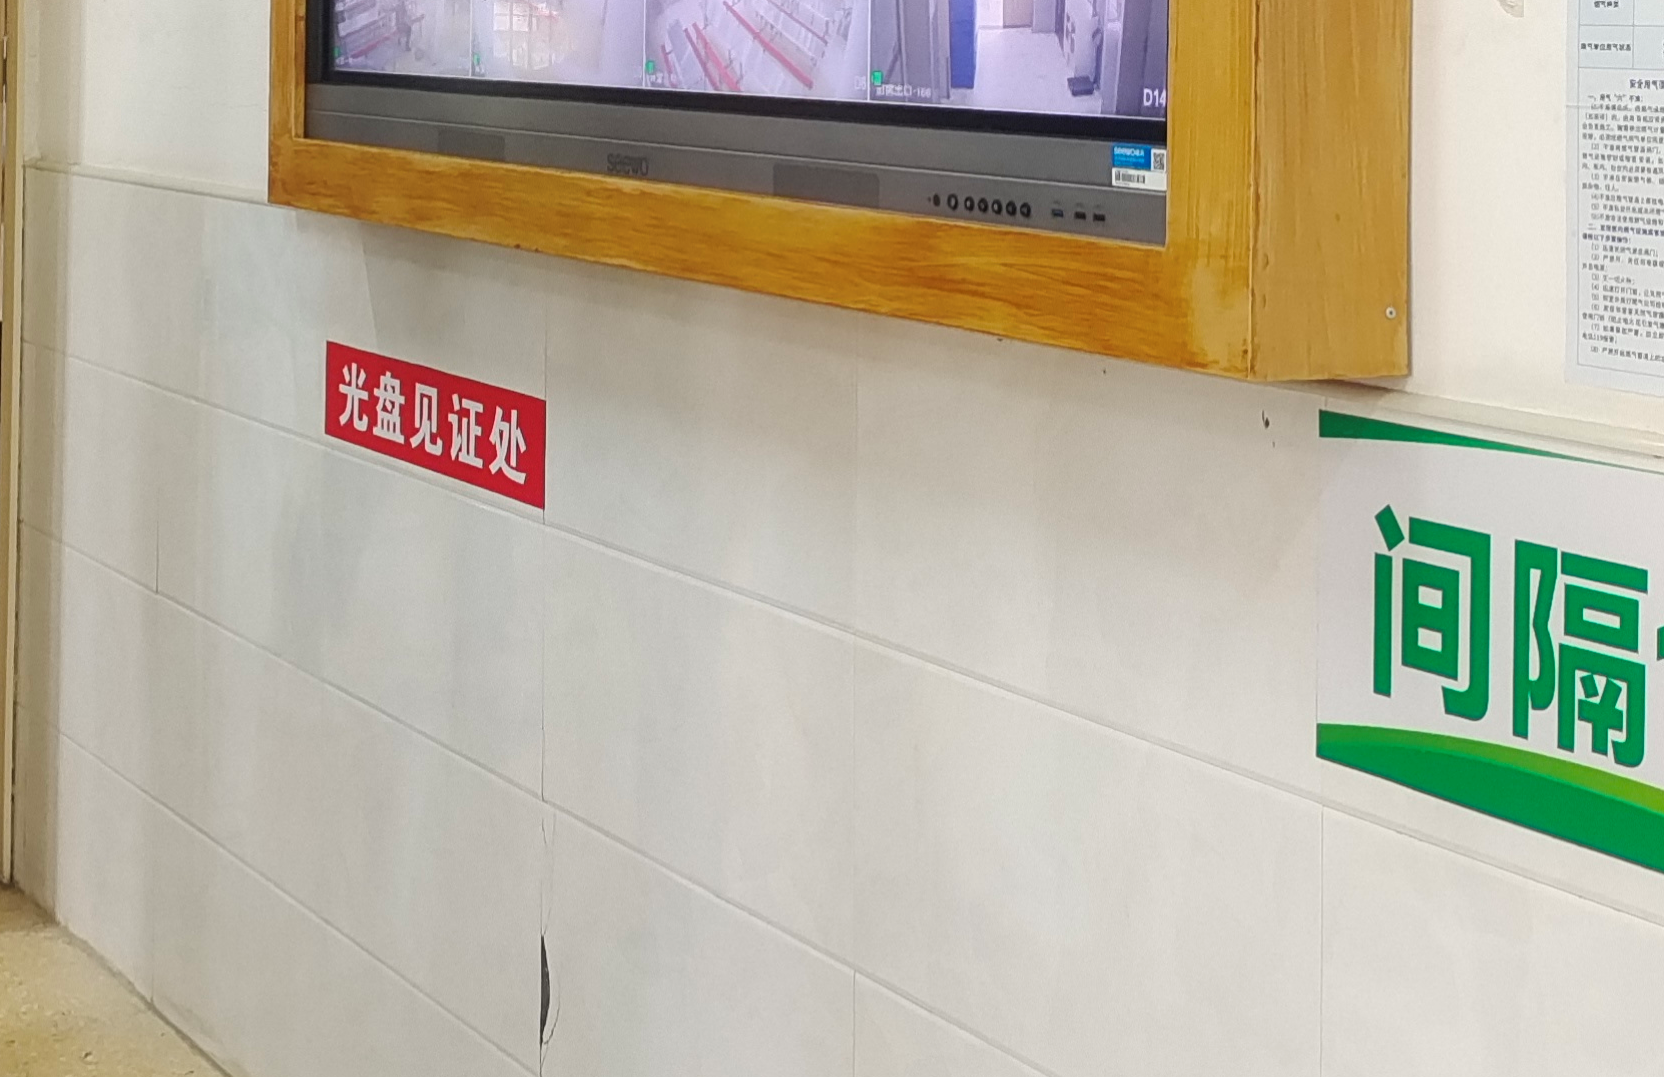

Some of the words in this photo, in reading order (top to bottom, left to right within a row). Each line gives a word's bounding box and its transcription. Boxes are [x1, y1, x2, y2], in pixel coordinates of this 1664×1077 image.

[1143, 88, 1167, 108] D14
[338, 361, 527, 485] 光盘见证处
[1373, 504, 1664, 769] 间隔
